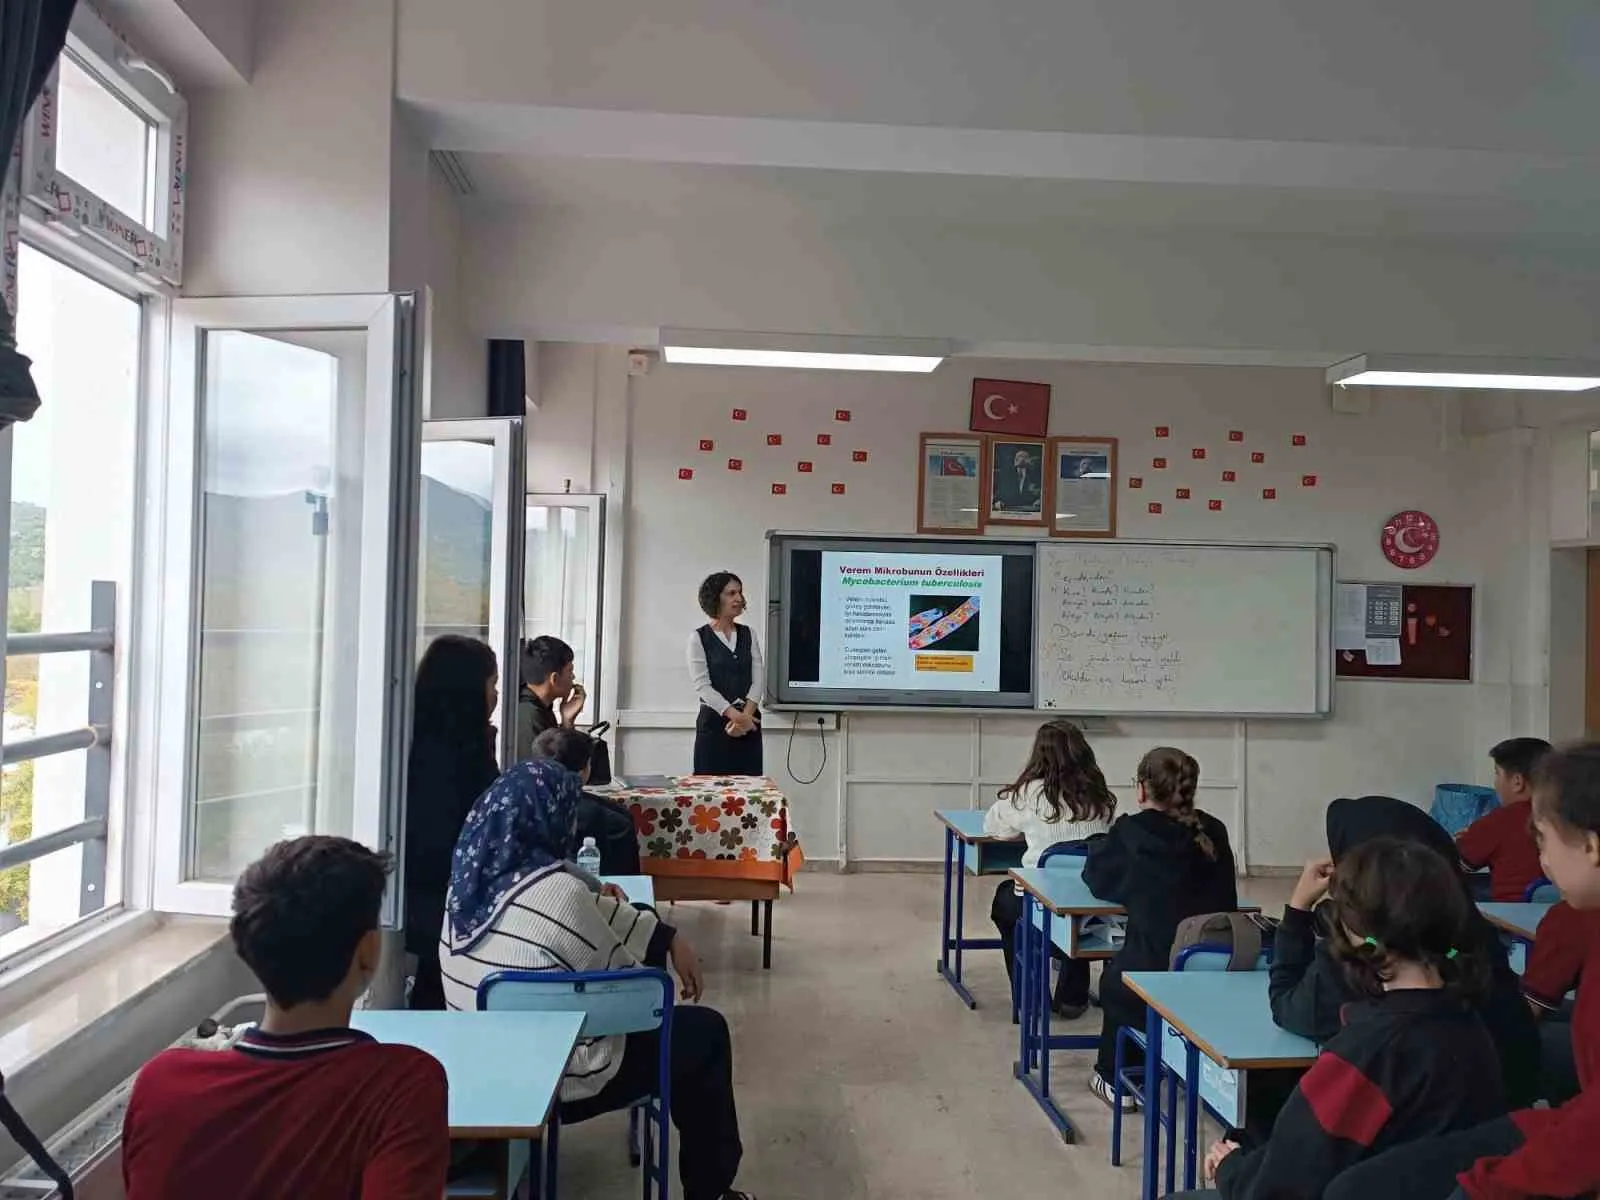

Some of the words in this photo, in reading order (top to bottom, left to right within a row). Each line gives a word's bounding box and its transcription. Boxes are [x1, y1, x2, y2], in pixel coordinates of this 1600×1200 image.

[839, 565, 871, 575] Verem
[874, 566, 932, 577] Mikrobunun
[935, 565, 985, 578] Özellikleri
[841, 576, 919, 587] Mycobacterium
[921, 578, 983, 589] tuberculosis
